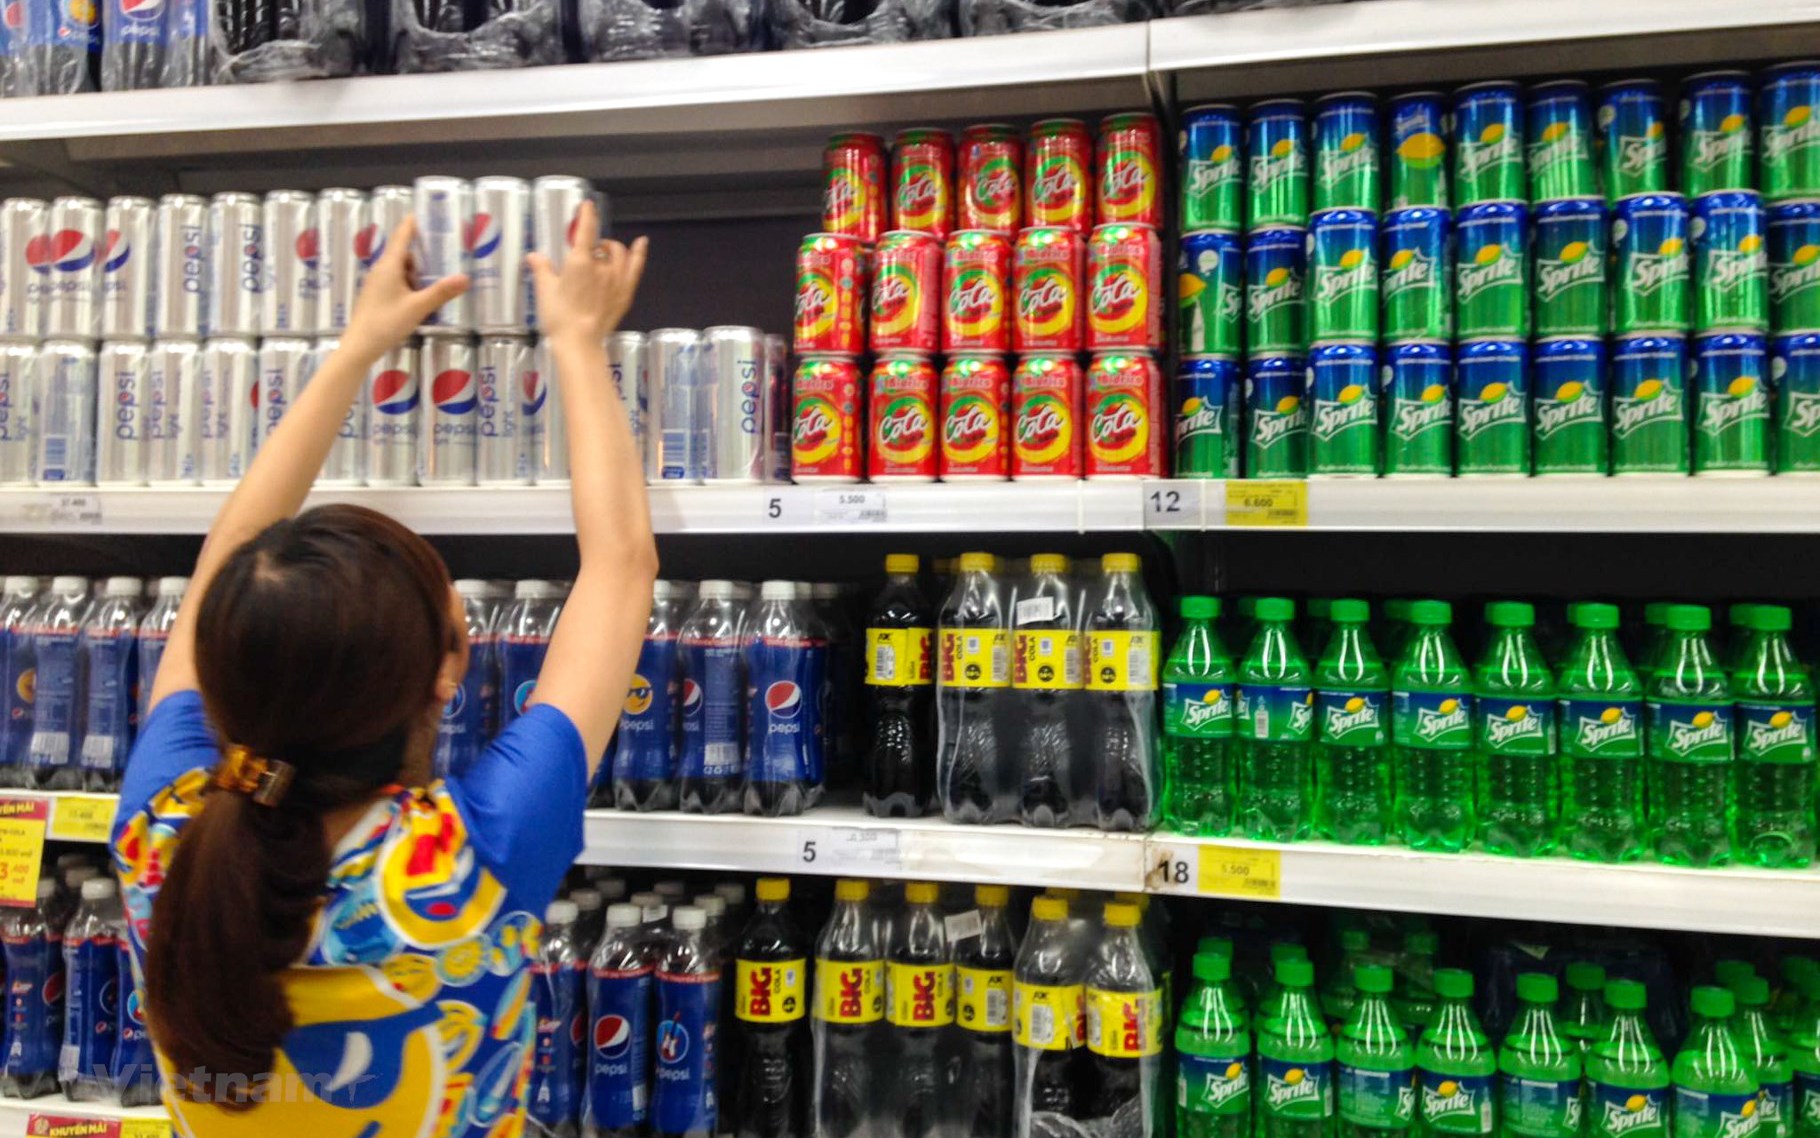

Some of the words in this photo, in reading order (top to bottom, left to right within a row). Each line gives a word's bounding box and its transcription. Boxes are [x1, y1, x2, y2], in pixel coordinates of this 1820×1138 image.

[976, 169, 1016, 200] Cola
[1033, 163, 1078, 205] Cola
[1102, 160, 1152, 200] Cola
[183, 224, 207, 294] pepsi
[950, 277, 996, 313] Cola
[1018, 276, 1069, 316] Cola
[1091, 272, 1142, 315] Cola
[115, 370, 139, 441] pepsi
[150, 370, 168, 440] pepsi
[480, 365, 500, 438] pepsi
[736, 359, 761, 435] pepsi
[1316, 394, 1374, 433] Sprite
[1459, 393, 1520, 434] Sprite
[1536, 392, 1597, 432] Sprite
[1614, 391, 1677, 431] Sprite
[1703, 389, 1767, 428] Sprite
[879, 404, 929, 445] Cola
[943, 404, 993, 445] Cola
[1017, 402, 1067, 444] Cola
[1091, 401, 1142, 444] Cola
[768, 498, 782, 518] 5
[1150, 490, 1181, 513] 12
[623, 718, 655, 732] pepsi
[768, 721, 800, 734] pepsi
[1186, 698, 1229, 726] Sprite
[1328, 705, 1375, 735] Sprite
[1419, 707, 1467, 738] Sprite
[1490, 712, 1538, 742] Sprite
[1581, 715, 1632, 746] Sprite
[1670, 719, 1723, 751] Sprite
[1748, 719, 1801, 751] Sprite
[803, 841, 816, 862] 5
[1157, 860, 1190, 884] 18
[750, 967, 772, 1016] BIG
[774, 969, 782, 995] COLA
[839, 968, 863, 1017] BIG
[864, 969, 872, 995] COLA
[913, 972, 936, 1021] BIG
[937, 973, 945, 998] COLA
[594, 1062, 628, 1077] pepsi
[658, 1067, 690, 1081] pepsi
[1269, 1076, 1315, 1102] Sprite
[1422, 1090, 1470, 1119] Sprite
[1605, 1102, 1657, 1132] Sprite
